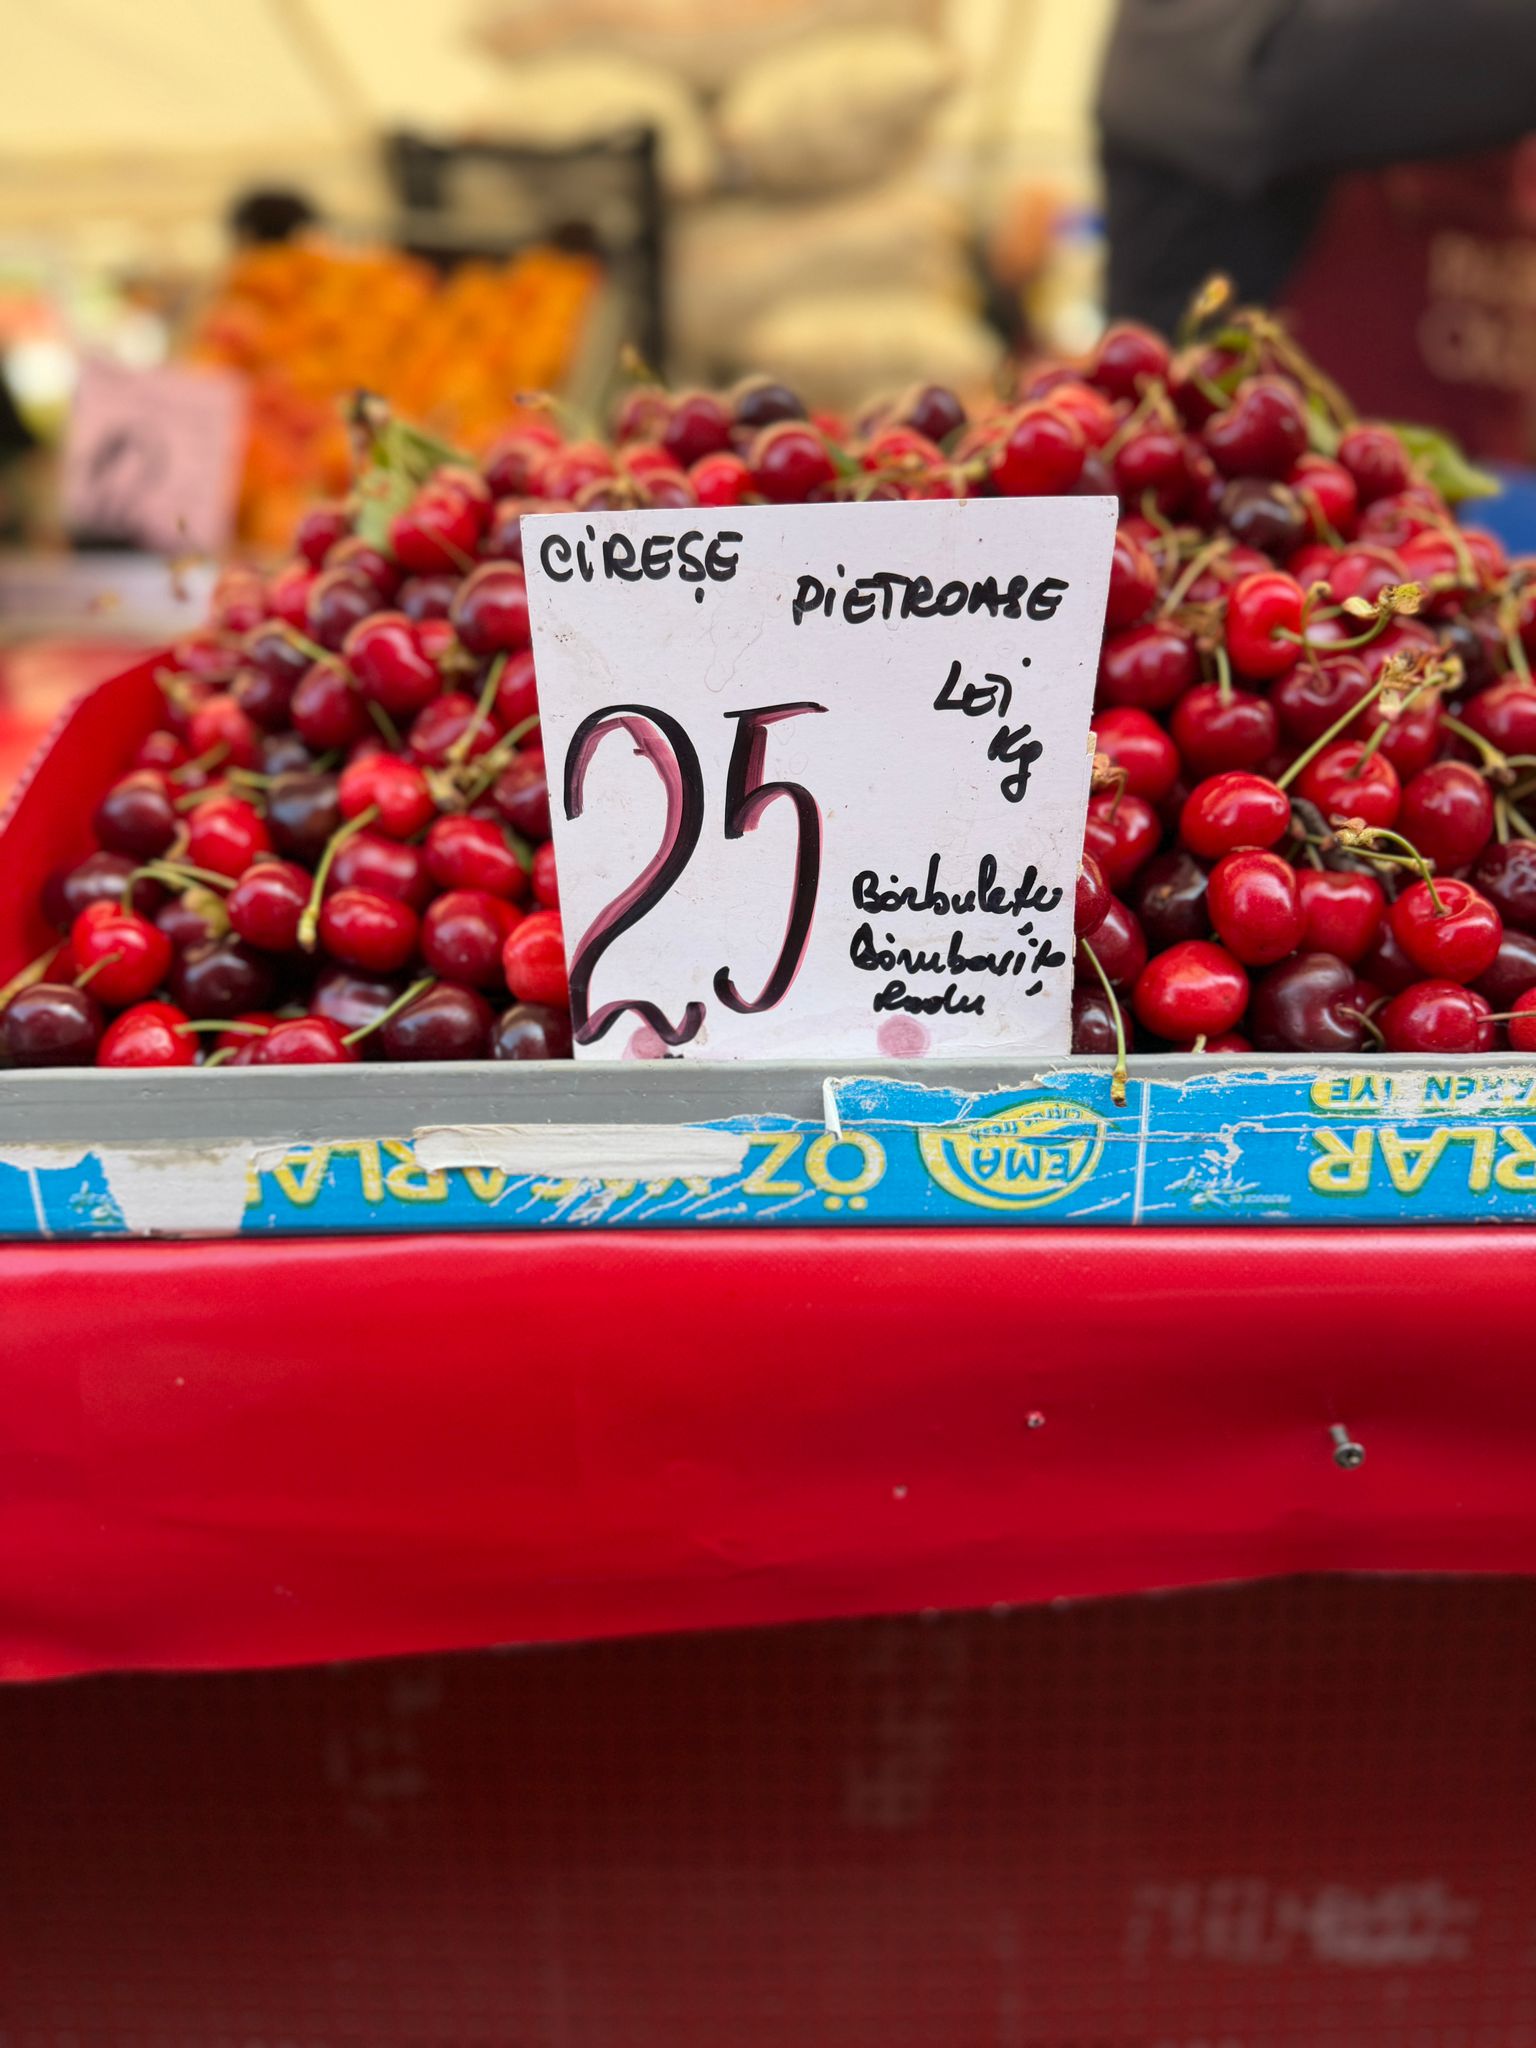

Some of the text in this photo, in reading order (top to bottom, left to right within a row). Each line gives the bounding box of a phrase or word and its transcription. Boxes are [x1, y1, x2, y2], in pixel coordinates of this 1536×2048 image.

[563, 702, 828, 1045] 25
[740, 1129, 888, 1211] ÖZ
[972, 1147, 1071, 1182] EMA
